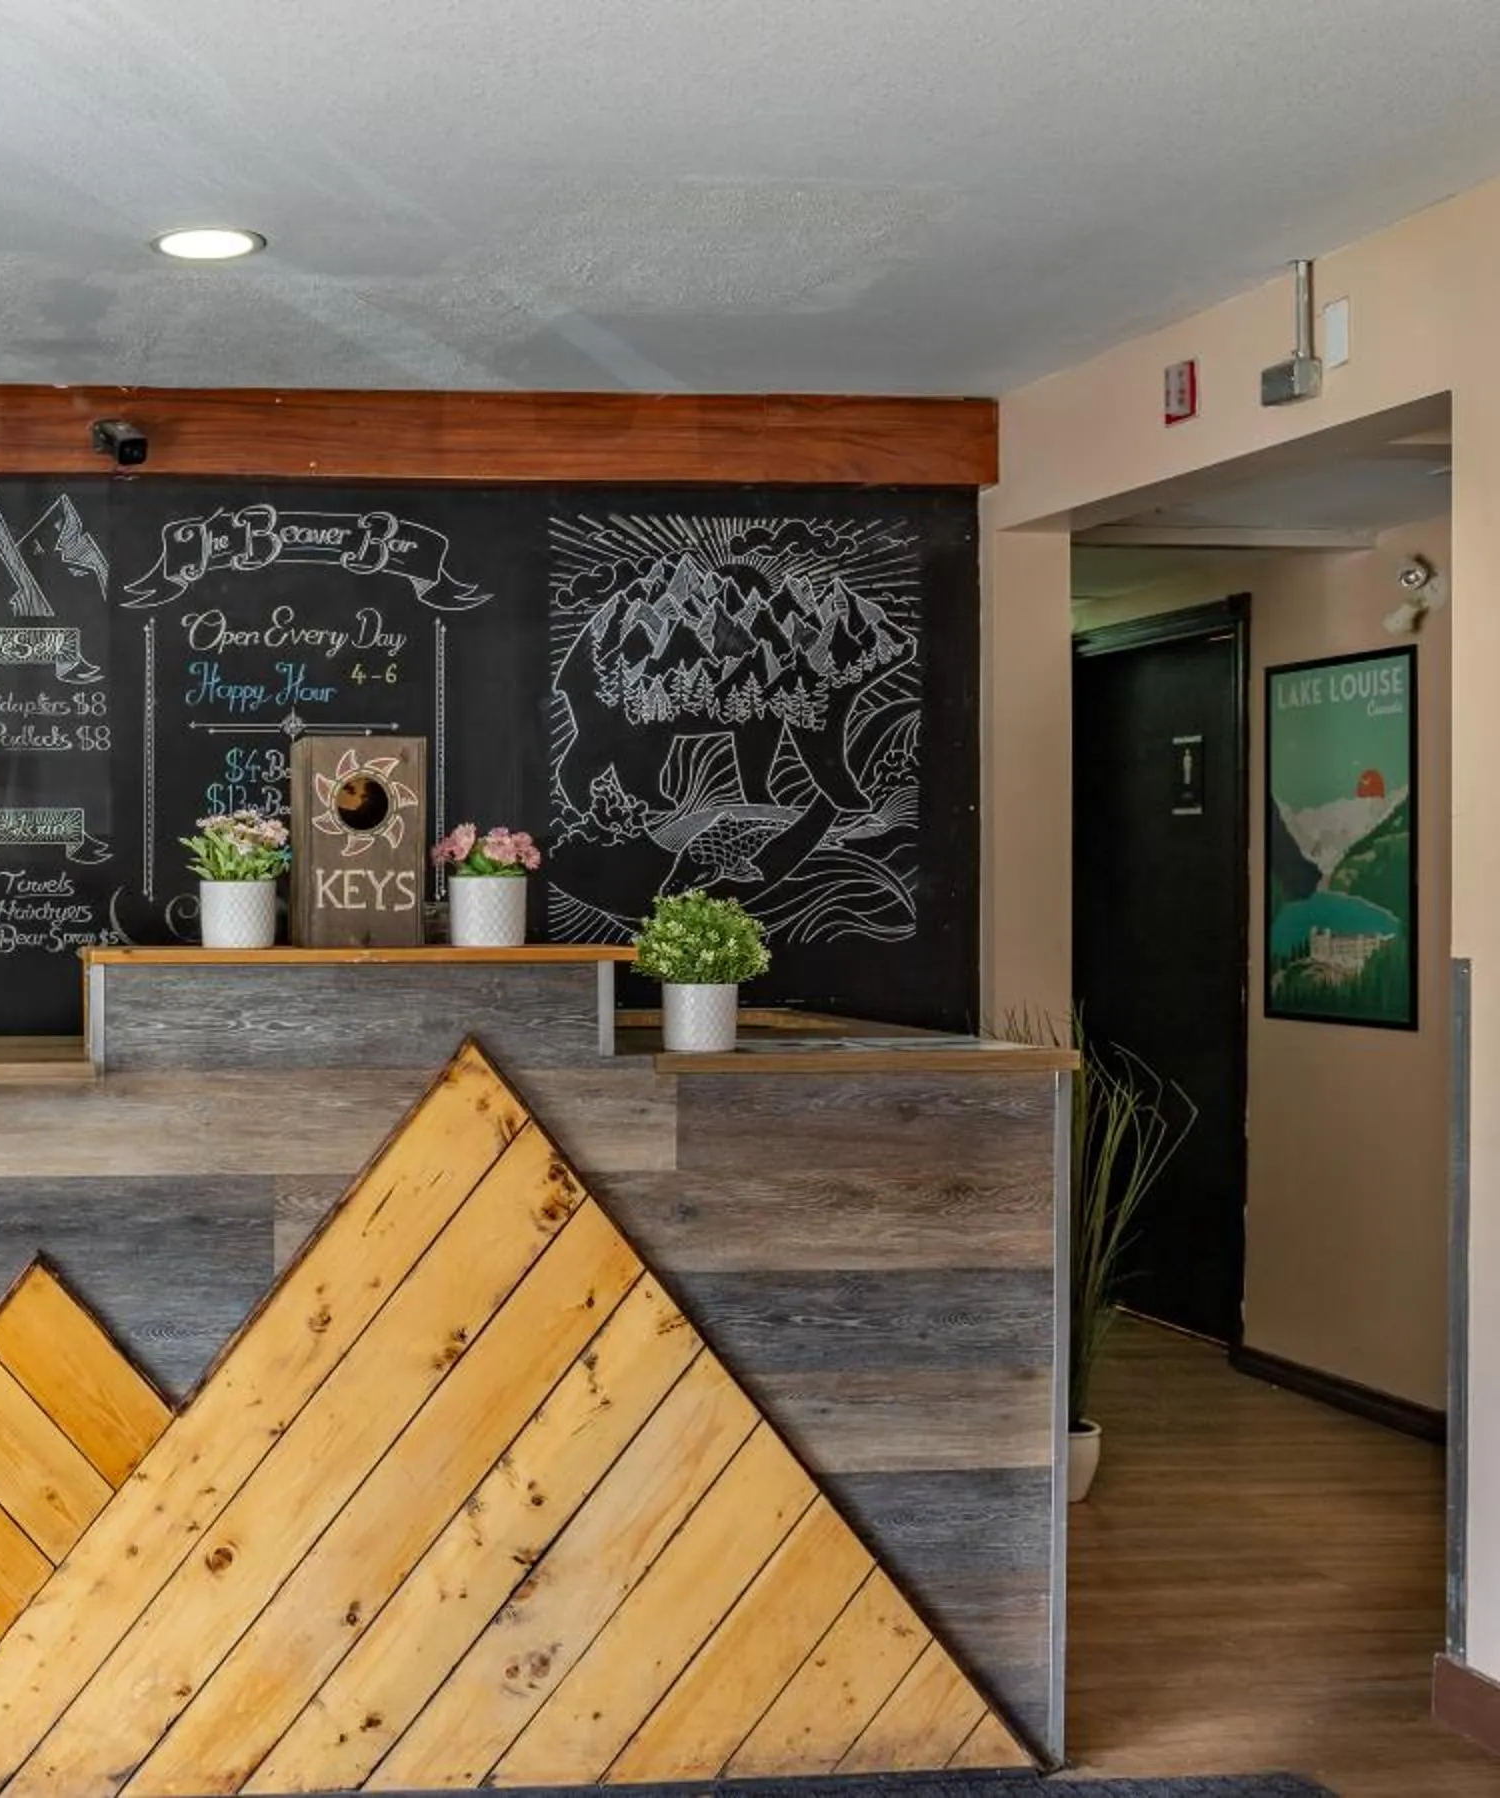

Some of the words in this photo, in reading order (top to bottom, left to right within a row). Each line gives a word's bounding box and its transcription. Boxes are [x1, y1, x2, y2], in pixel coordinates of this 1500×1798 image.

[173, 507, 229, 581] The
[230, 504, 351, 570] Beaver
[340, 512, 418, 574] Bar
[13, 631, 64, 658] Sell
[181, 609, 260, 654] Open
[264, 605, 348, 658] Every
[351, 607, 406, 657] Day
[72, 691, 107, 716] $8
[185, 661, 272, 712] Happy
[275, 661, 337, 704] Hour
[1278, 679, 1322, 710] LAKE
[1329, 665, 1403, 703] LOUISE
[75, 725, 111, 750] $8
[225, 747, 260, 783] $4
[315, 868, 416, 912] KEYS
